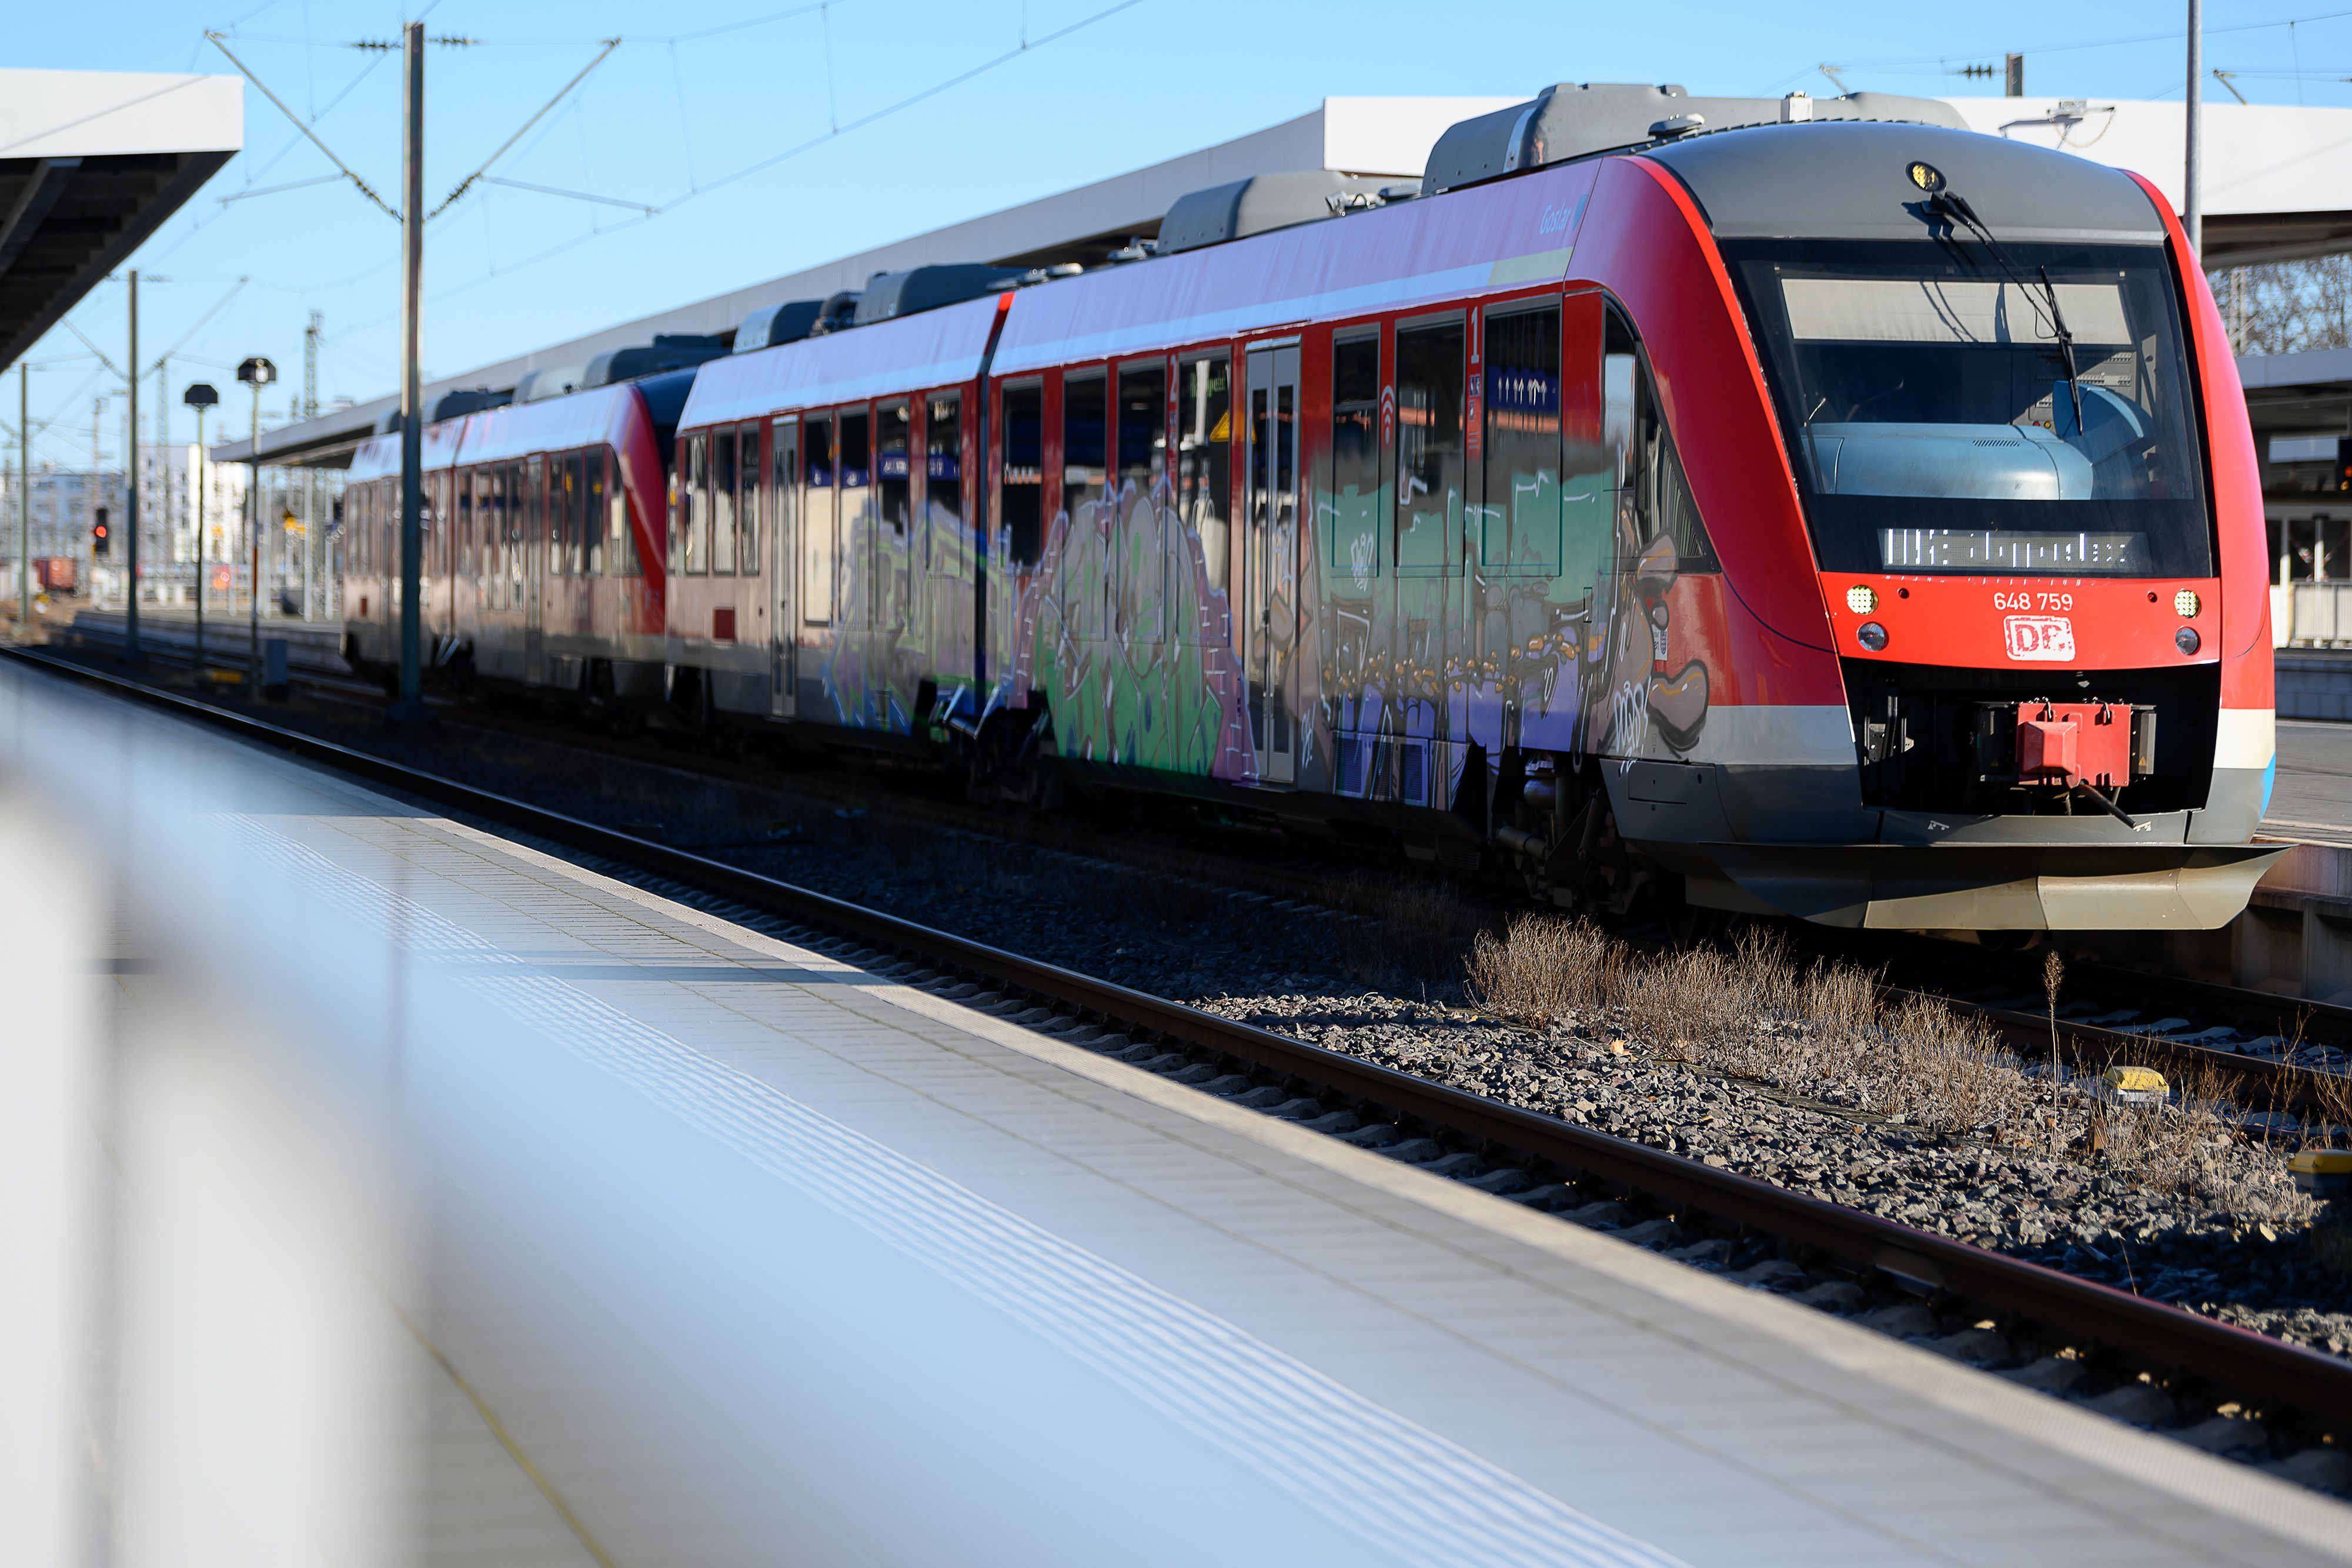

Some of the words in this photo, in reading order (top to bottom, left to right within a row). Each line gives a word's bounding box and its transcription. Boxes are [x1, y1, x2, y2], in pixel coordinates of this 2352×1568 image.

[1540, 201, 1572, 235] Goslar
[1471, 306, 1479, 364] 1
[1170, 354, 1177, 403] 2
[1993, 592, 2031, 610] 648
[2037, 593, 2073, 611] 759
